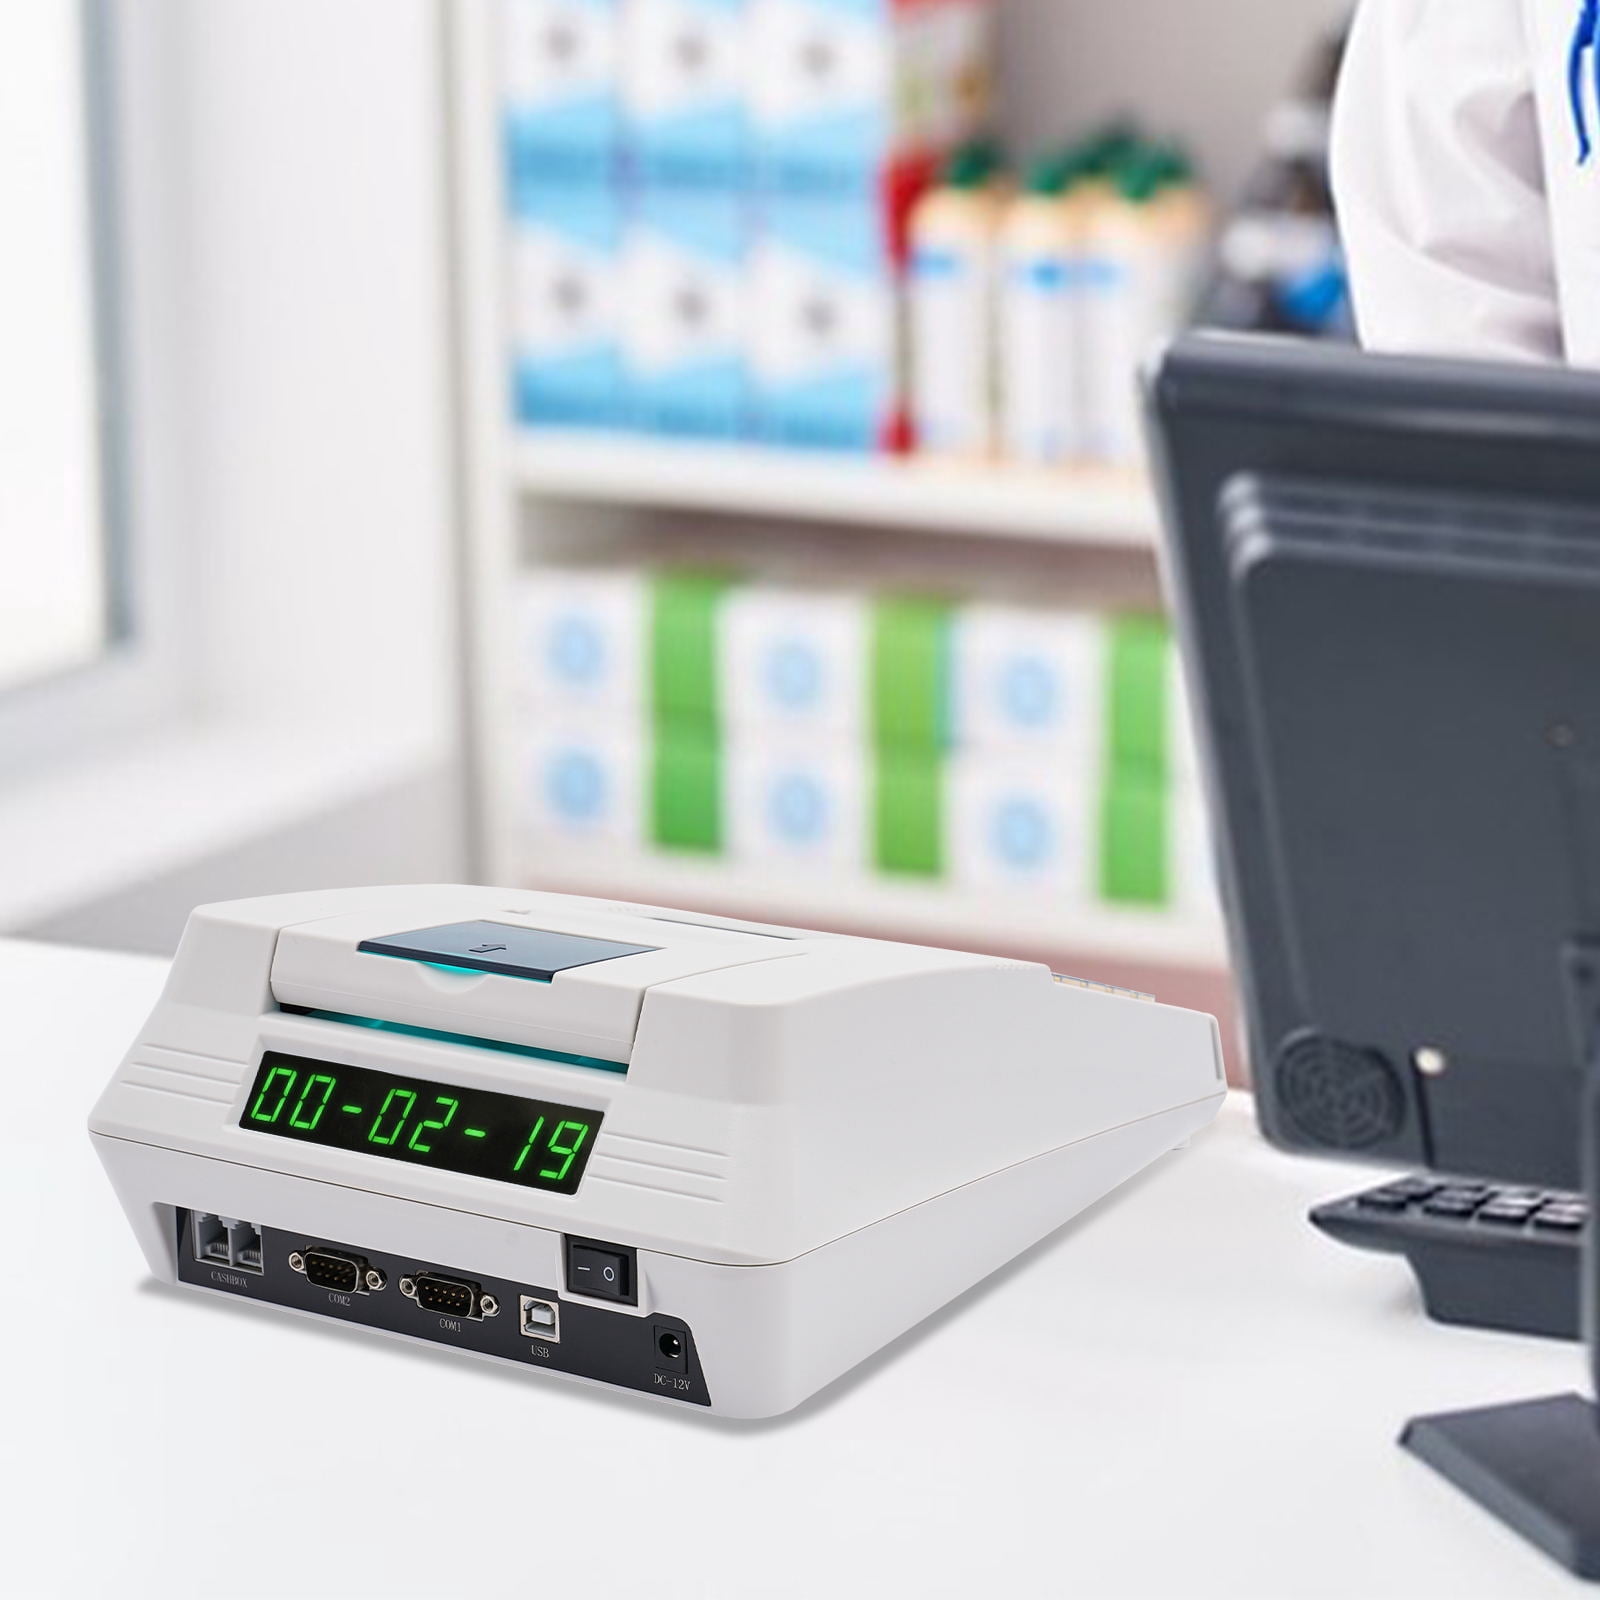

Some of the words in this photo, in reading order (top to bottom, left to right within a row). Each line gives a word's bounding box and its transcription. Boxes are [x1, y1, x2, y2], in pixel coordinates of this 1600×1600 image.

[251, 1067, 589, 1180] 00-02-19
[210, 1271, 248, 1289] CASHBOX
[328, 1292, 351, 1307] COM2
[439, 1317, 462, 1333] COM1
[531, 1344, 550, 1359] USB
[653, 1373, 691, 1391] DC-12V
